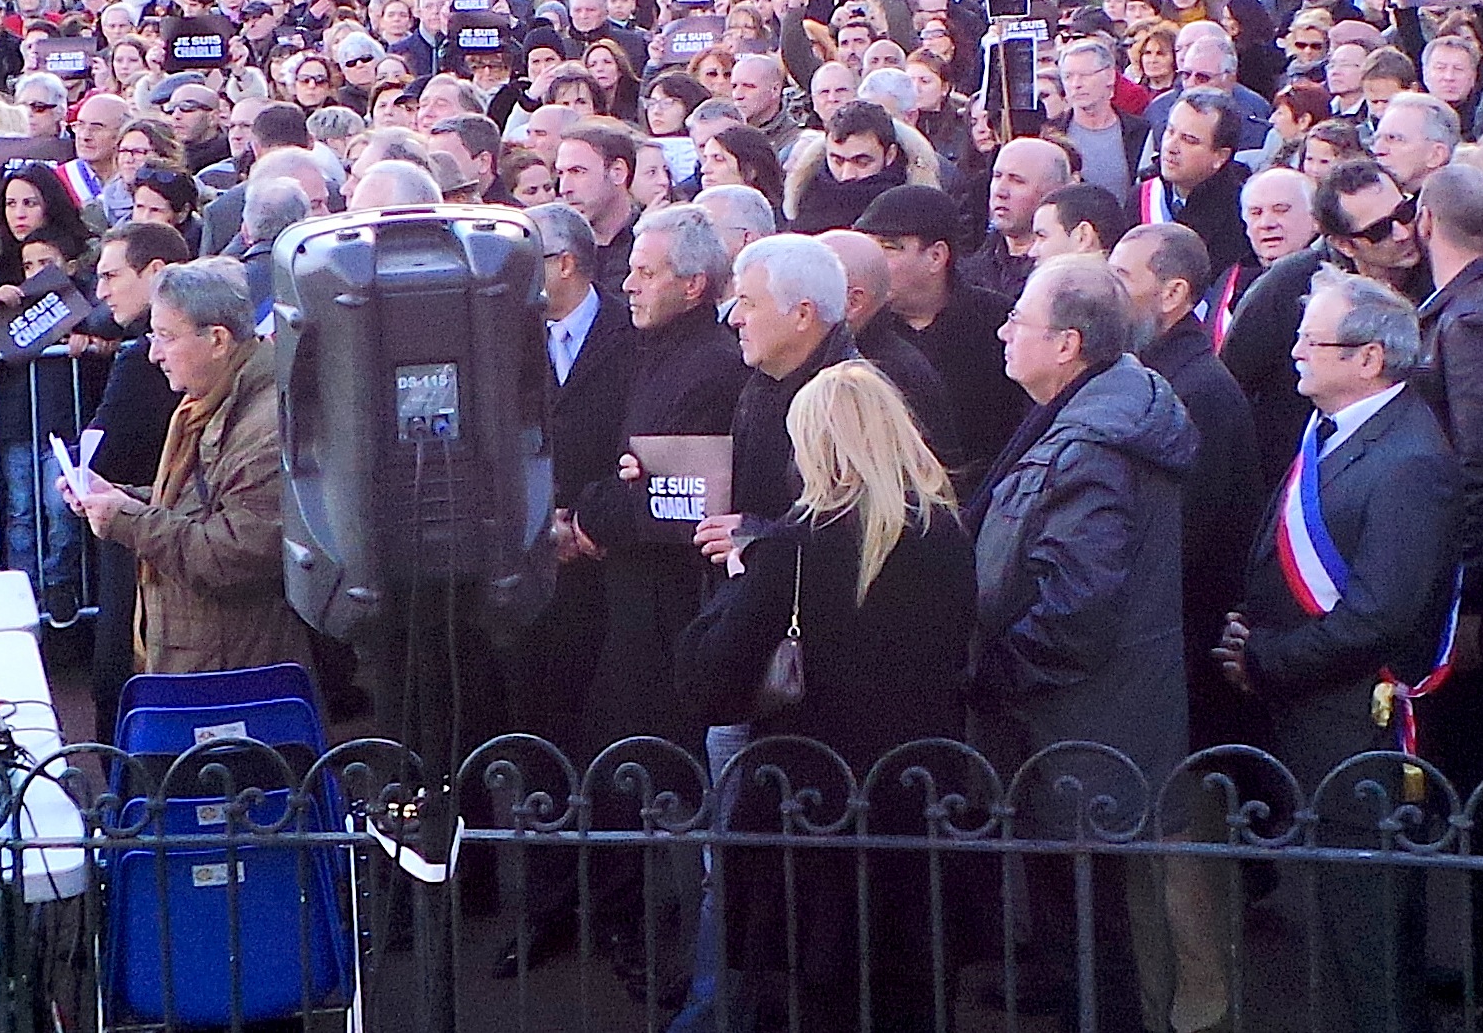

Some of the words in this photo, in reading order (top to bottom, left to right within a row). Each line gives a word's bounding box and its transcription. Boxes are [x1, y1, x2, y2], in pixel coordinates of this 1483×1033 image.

[460, 29, 473, 37] JE
[474, 28, 499, 37] SUIS
[174, 37, 190, 47] JE
[192, 35, 222, 45] SUIS
[459, 36, 500, 47] CHARLIE
[46, 52, 60, 61] JE
[62, 51, 85, 60] SUIS
[174, 45, 222, 58] CHARLIE
[47, 60, 86, 71] CHARLIE
[8, 316, 27, 336] JE
[25, 292, 60, 320] SUIS
[13, 301, 70, 348] CHARLIE
[648, 477, 667, 495] JE
[667, 477, 705, 495] SUIS
[650, 496, 705, 521] CHARLIE
